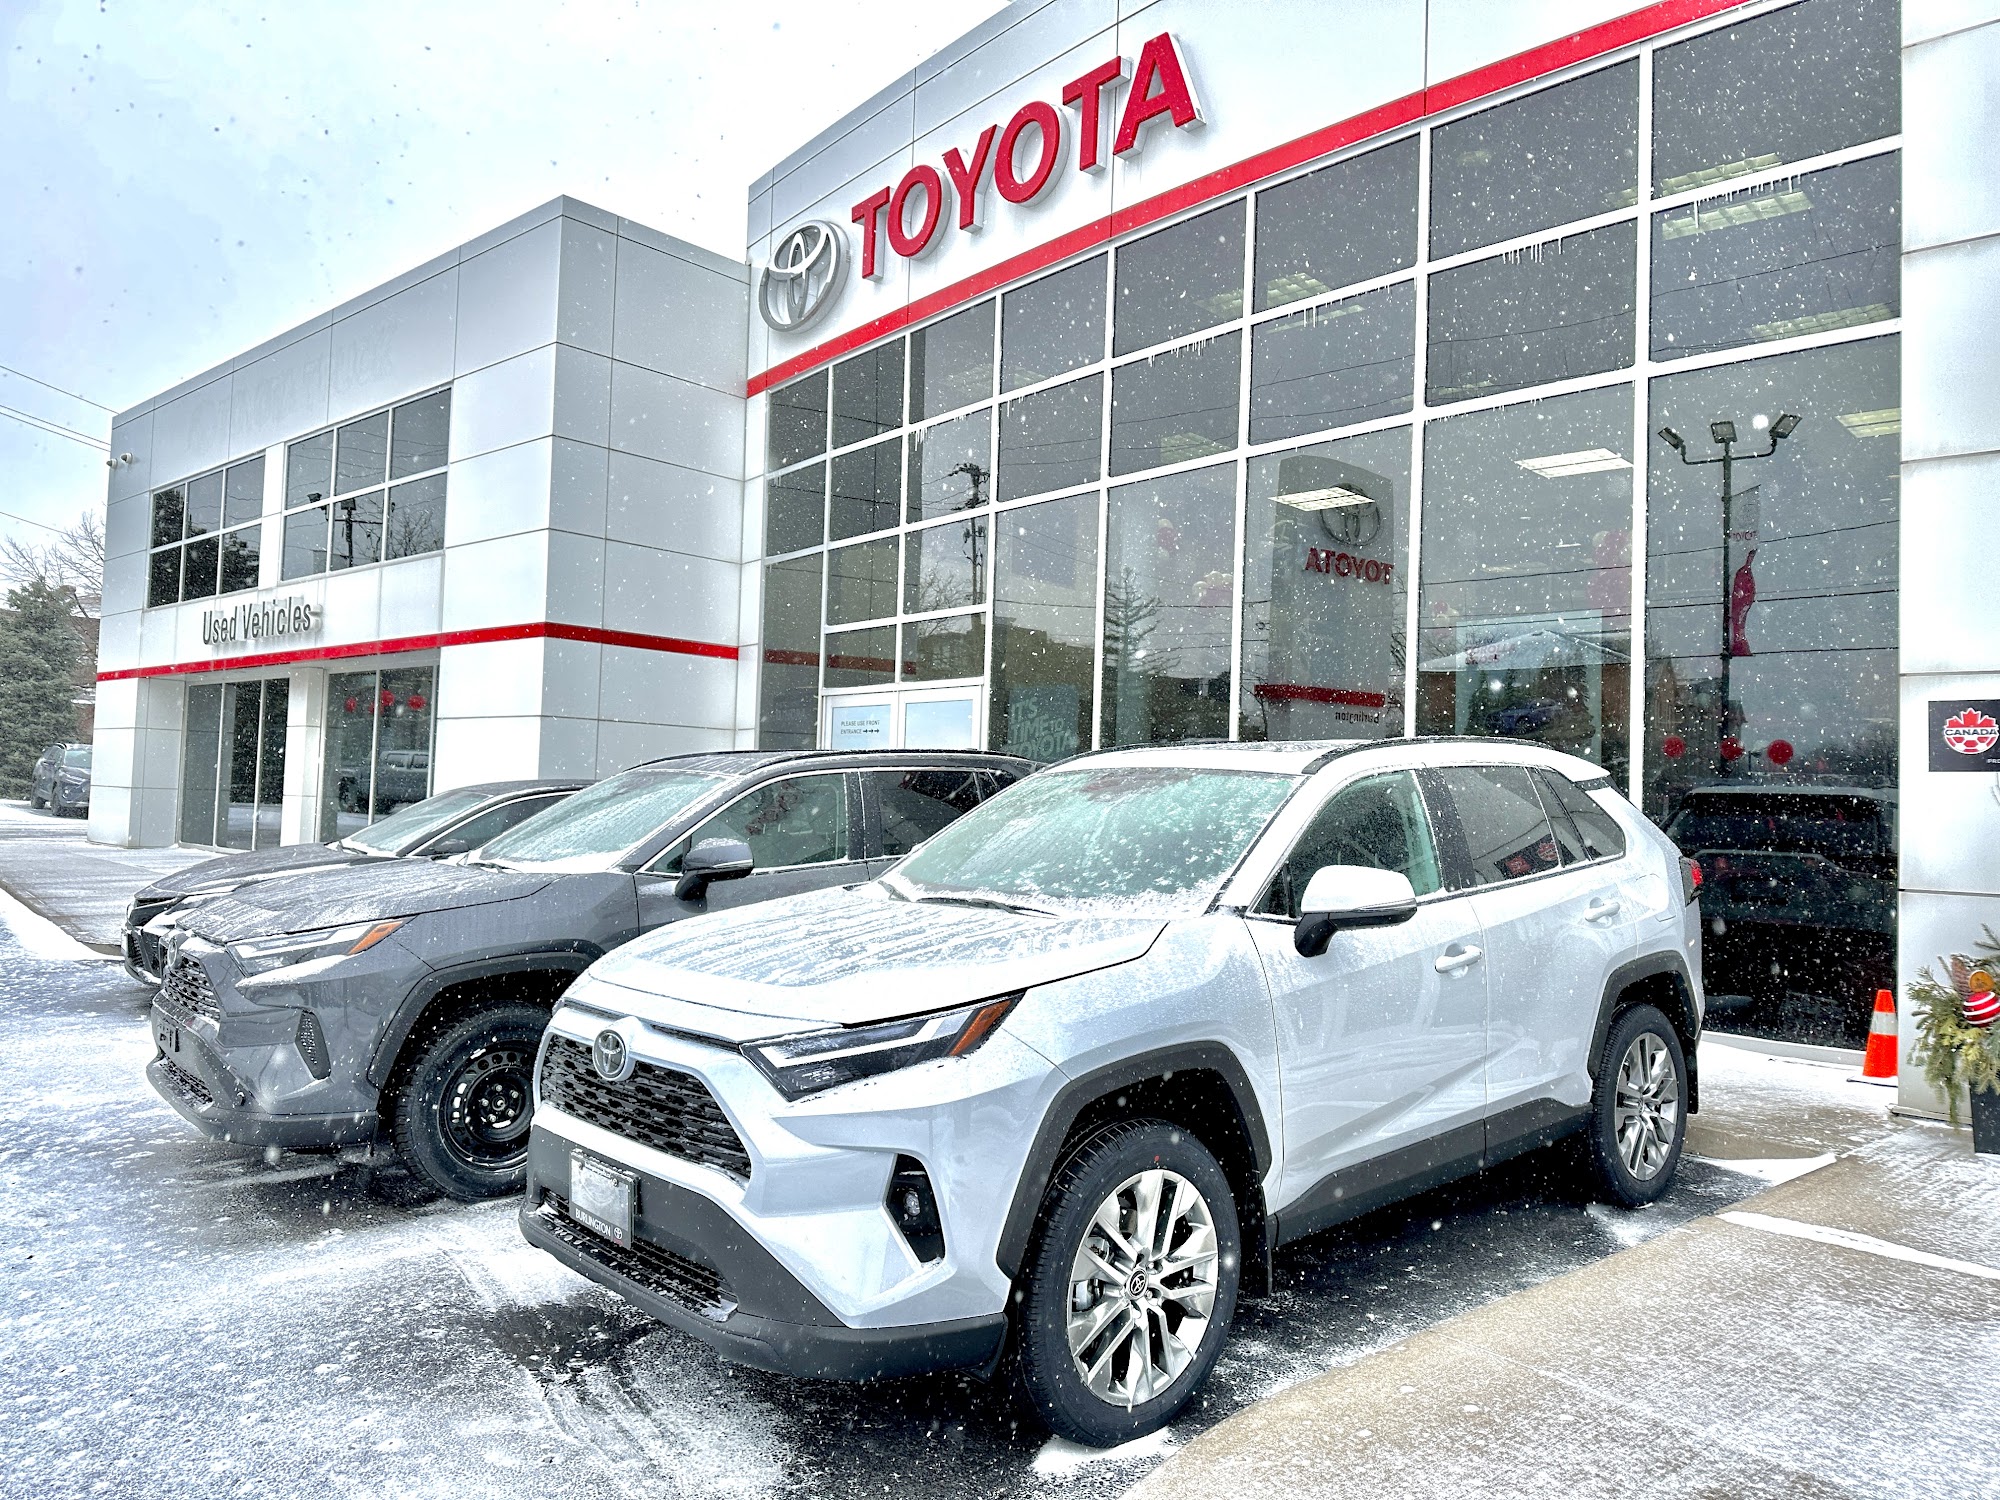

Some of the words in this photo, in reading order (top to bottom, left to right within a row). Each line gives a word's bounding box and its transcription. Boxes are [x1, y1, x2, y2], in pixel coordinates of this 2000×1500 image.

[851, 32, 1202, 279] TOYOTA
[203, 605, 238, 645] Used
[243, 596, 311, 639] Vehicles
[1011, 697, 1038, 724] IT'S
[1010, 714, 1050, 745] TIME
[575, 1207, 611, 1237] BURLINGTON
